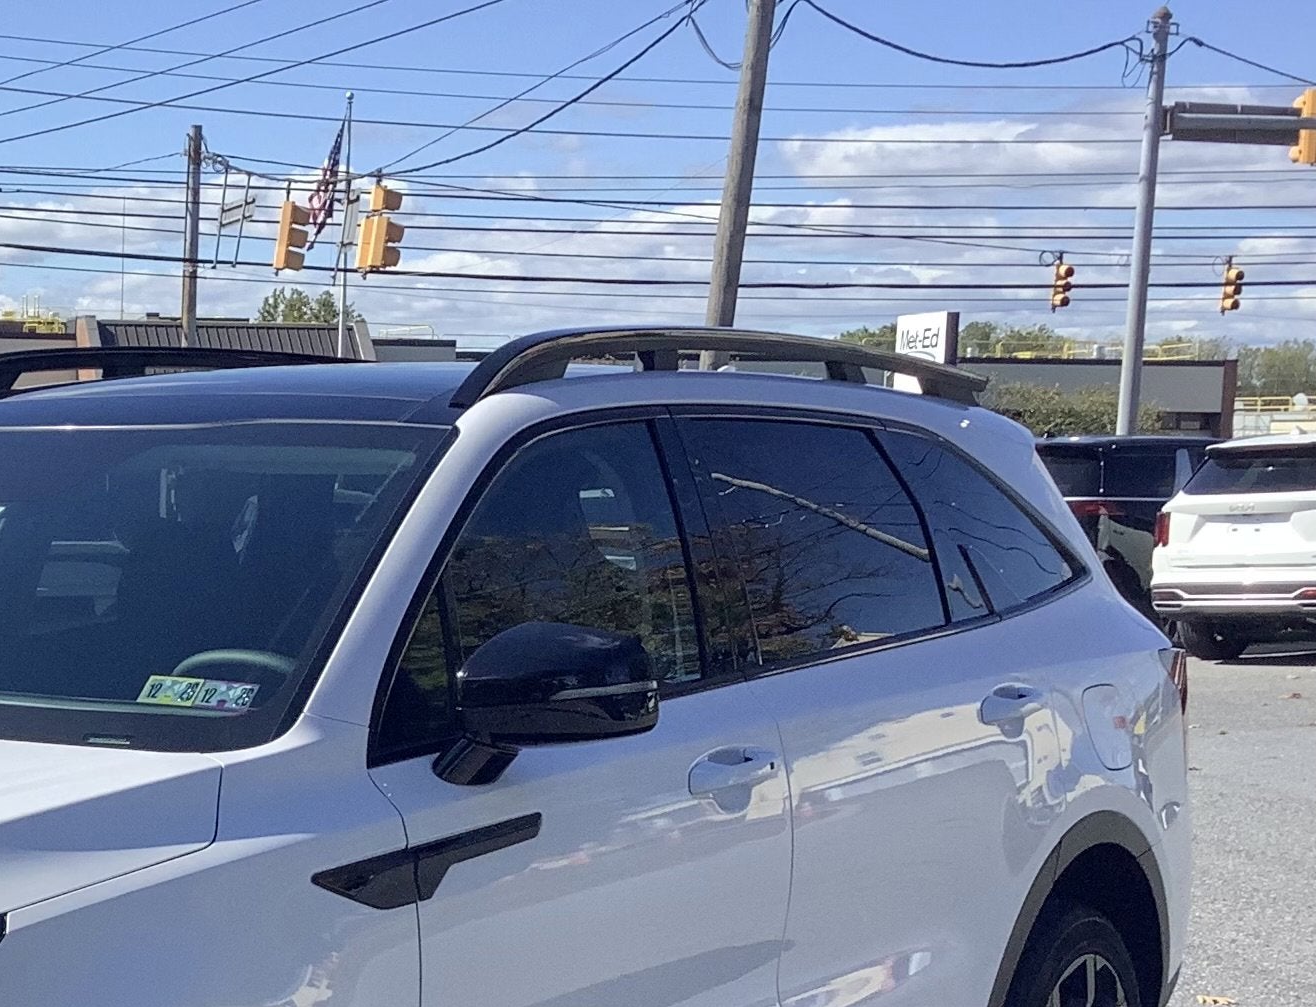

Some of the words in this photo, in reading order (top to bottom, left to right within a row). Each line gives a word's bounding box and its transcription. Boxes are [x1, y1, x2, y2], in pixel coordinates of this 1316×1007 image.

[900, 327, 940, 350] Met-Ed
[146, 683, 163, 699] 12
[201, 687, 217, 703] 12
